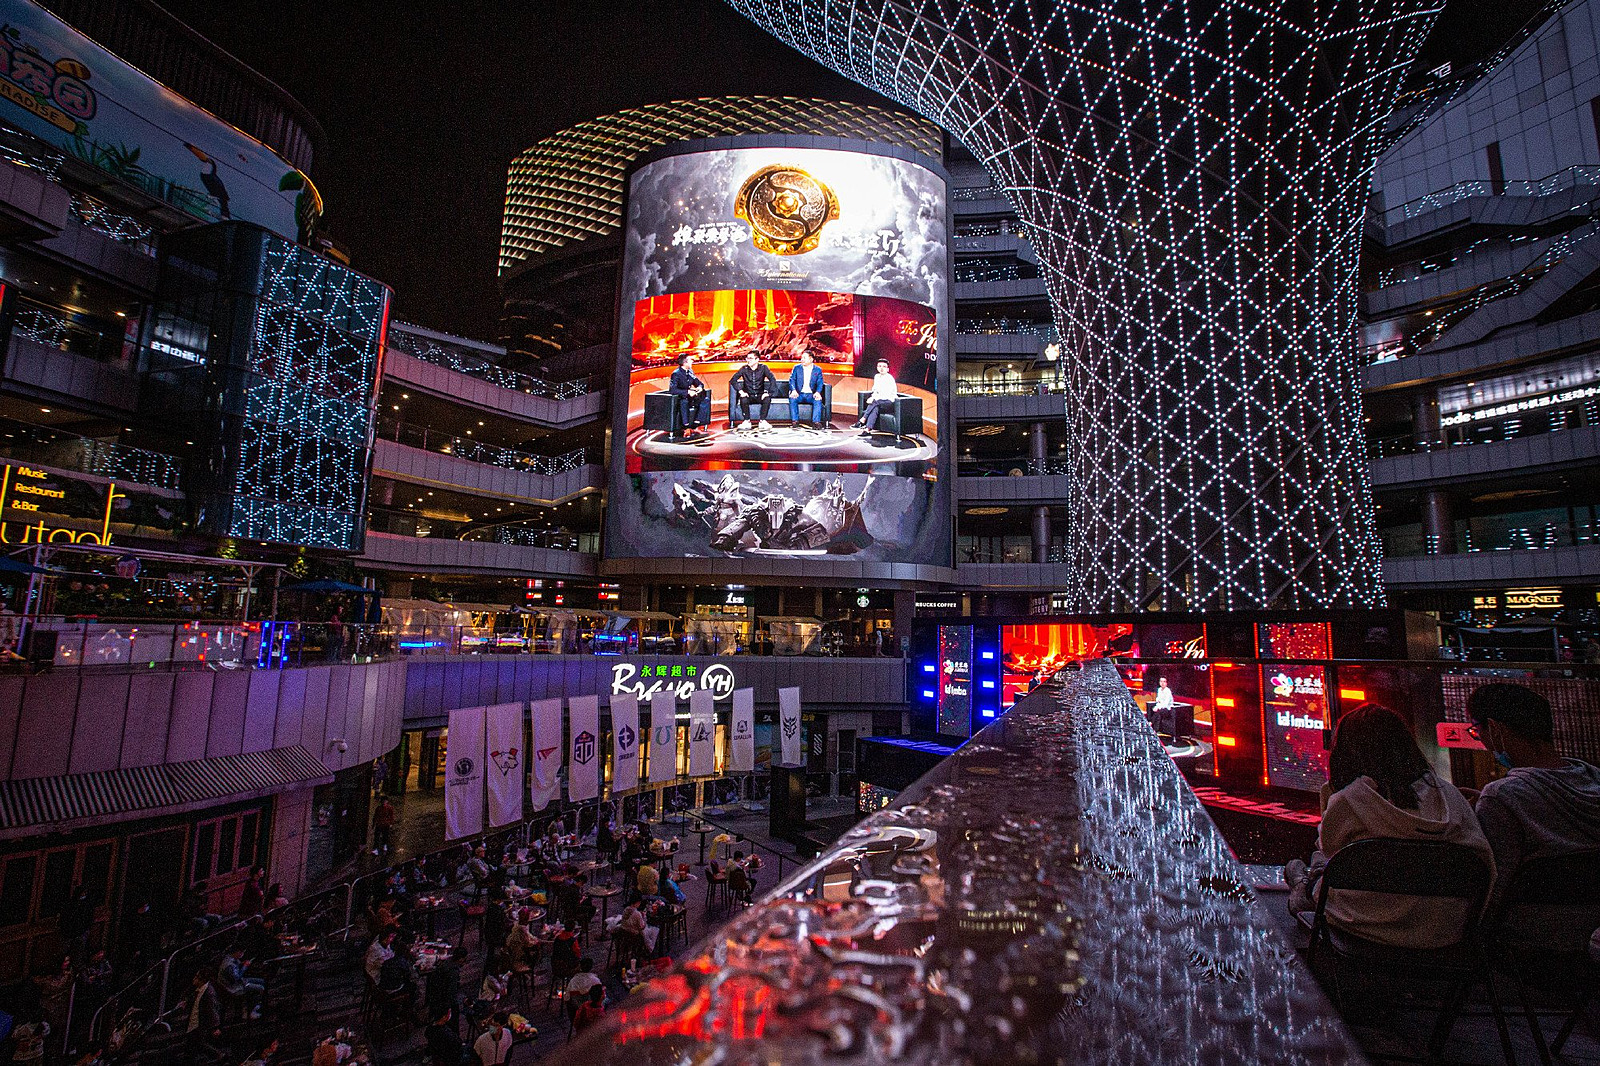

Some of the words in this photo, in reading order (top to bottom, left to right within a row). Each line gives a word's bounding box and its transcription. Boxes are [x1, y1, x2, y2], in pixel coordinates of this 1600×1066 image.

[896, 319, 919, 336] The
[17, 466, 48, 480] Music
[14, 482, 65, 499] Restaurant
[1506, 595, 1561, 604] MAGNET
[640, 665, 697, 678] 永辉超市
[707, 674, 732, 692] YH
